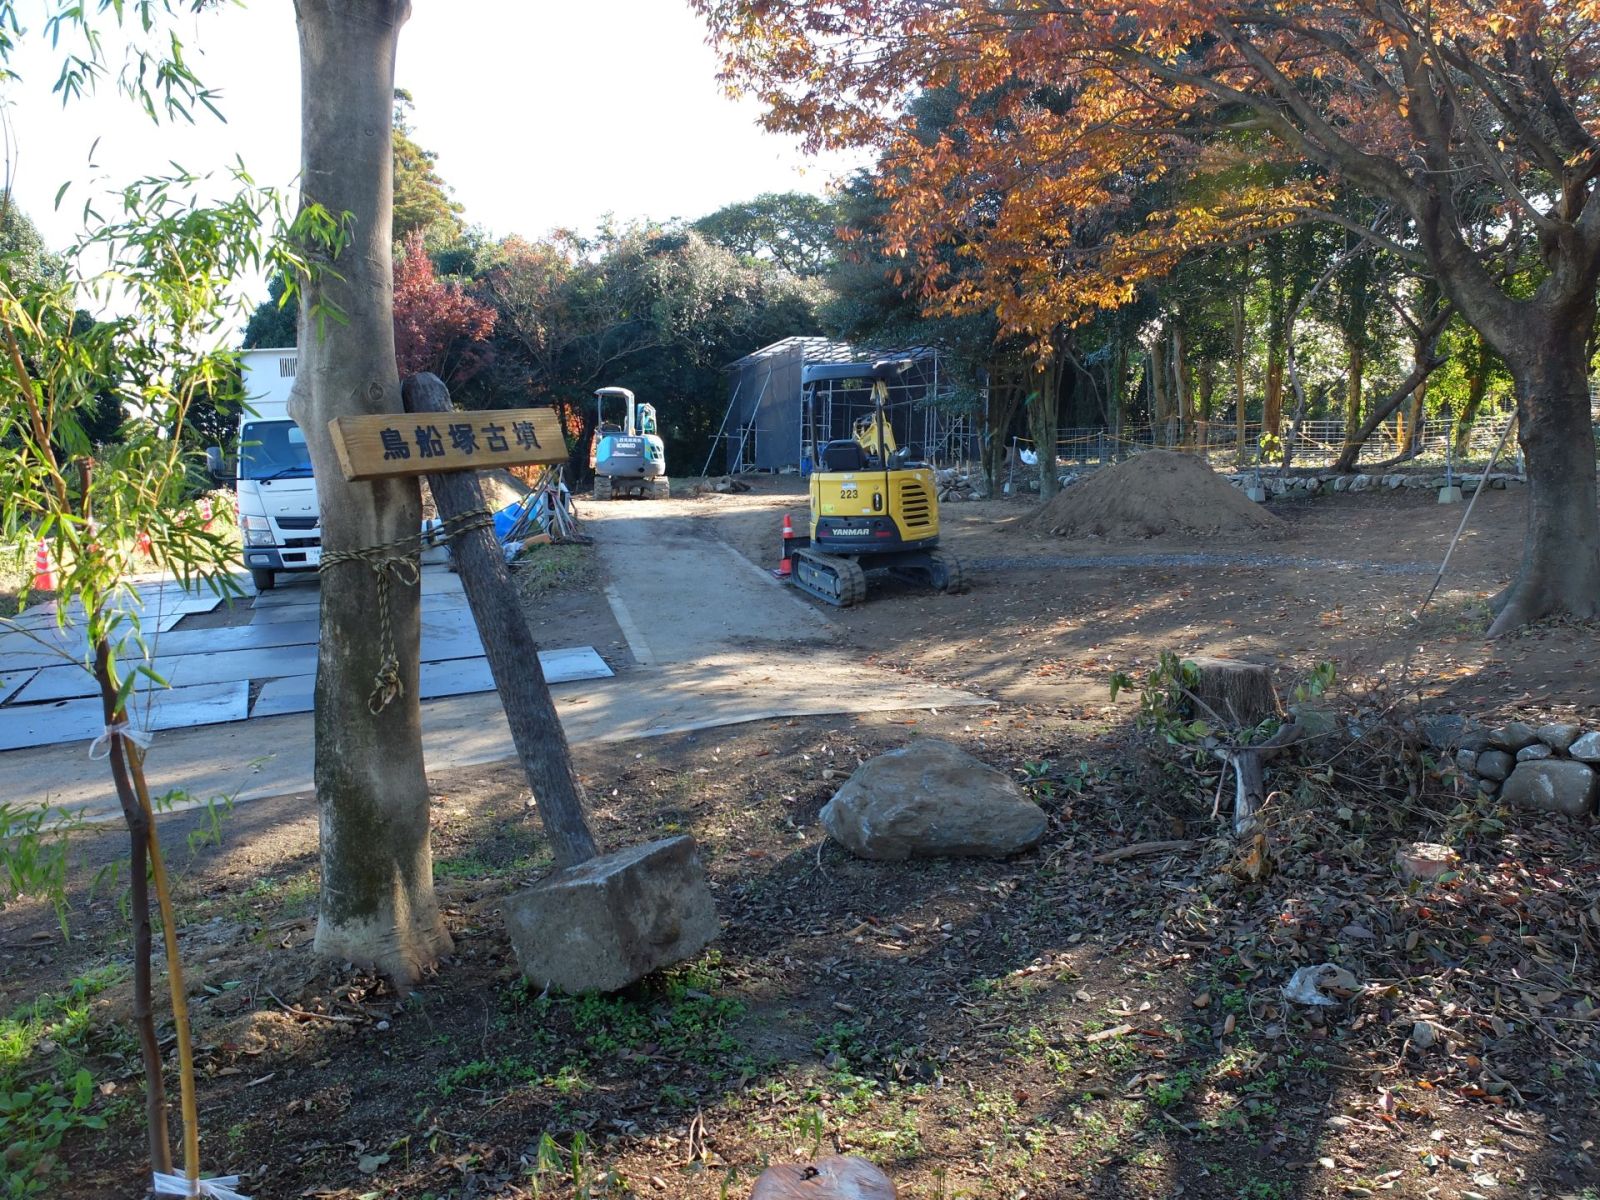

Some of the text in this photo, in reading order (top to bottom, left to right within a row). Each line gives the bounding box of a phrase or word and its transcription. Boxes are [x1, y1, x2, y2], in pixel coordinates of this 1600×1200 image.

[380, 421, 541, 460] 鳥船塚古墳
[840, 489, 858, 499] 223
[832, 528, 870, 536] YANMAR
